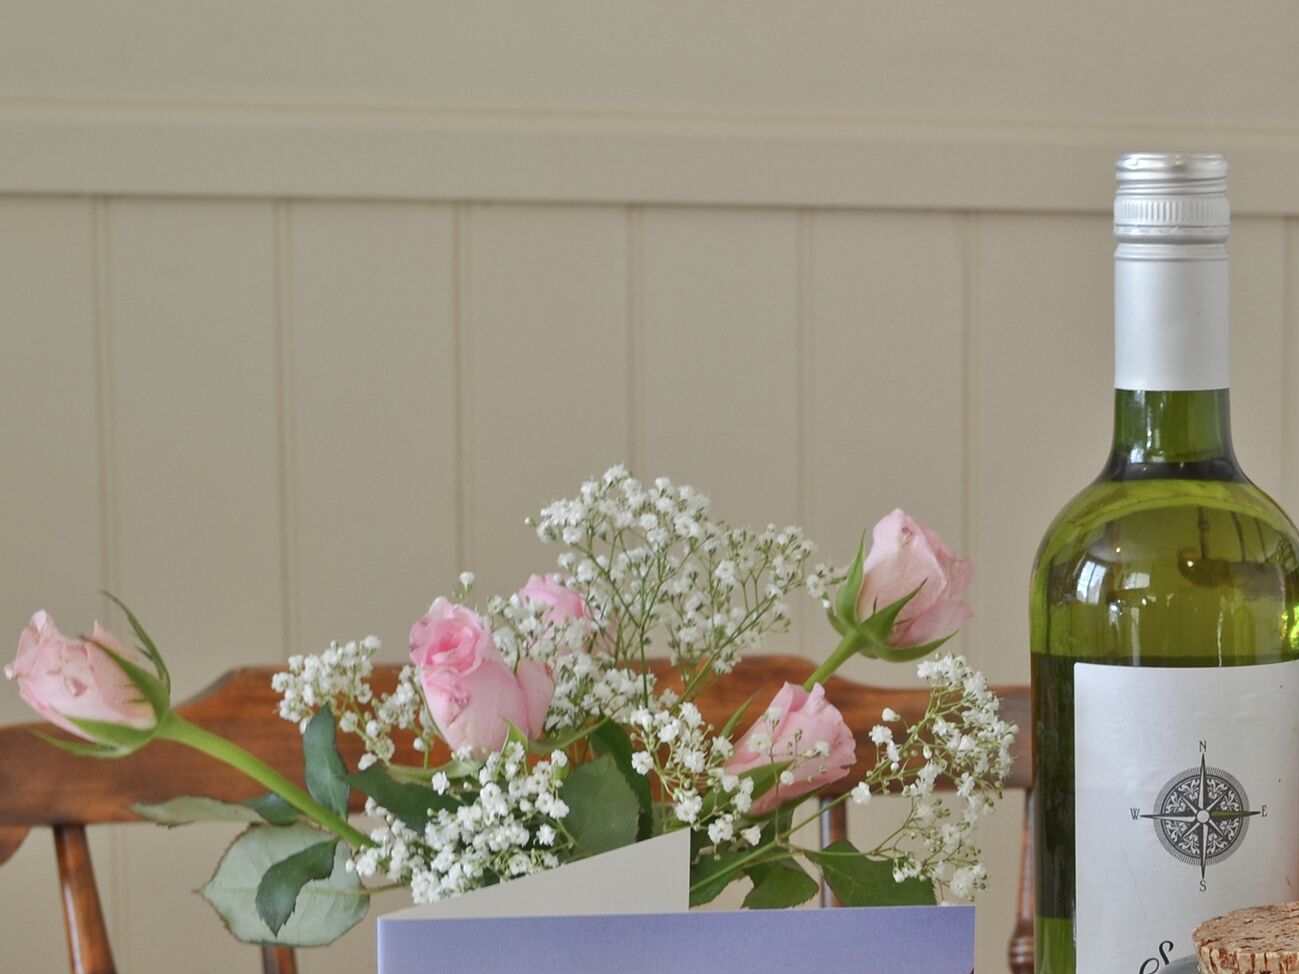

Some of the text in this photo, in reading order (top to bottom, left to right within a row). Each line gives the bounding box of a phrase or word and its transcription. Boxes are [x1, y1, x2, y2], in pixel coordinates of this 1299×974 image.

[1199, 740, 1207, 752] N
[1130, 808, 1140, 820] W
[1261, 805, 1268, 817] E
[1199, 880, 1207, 892] S
